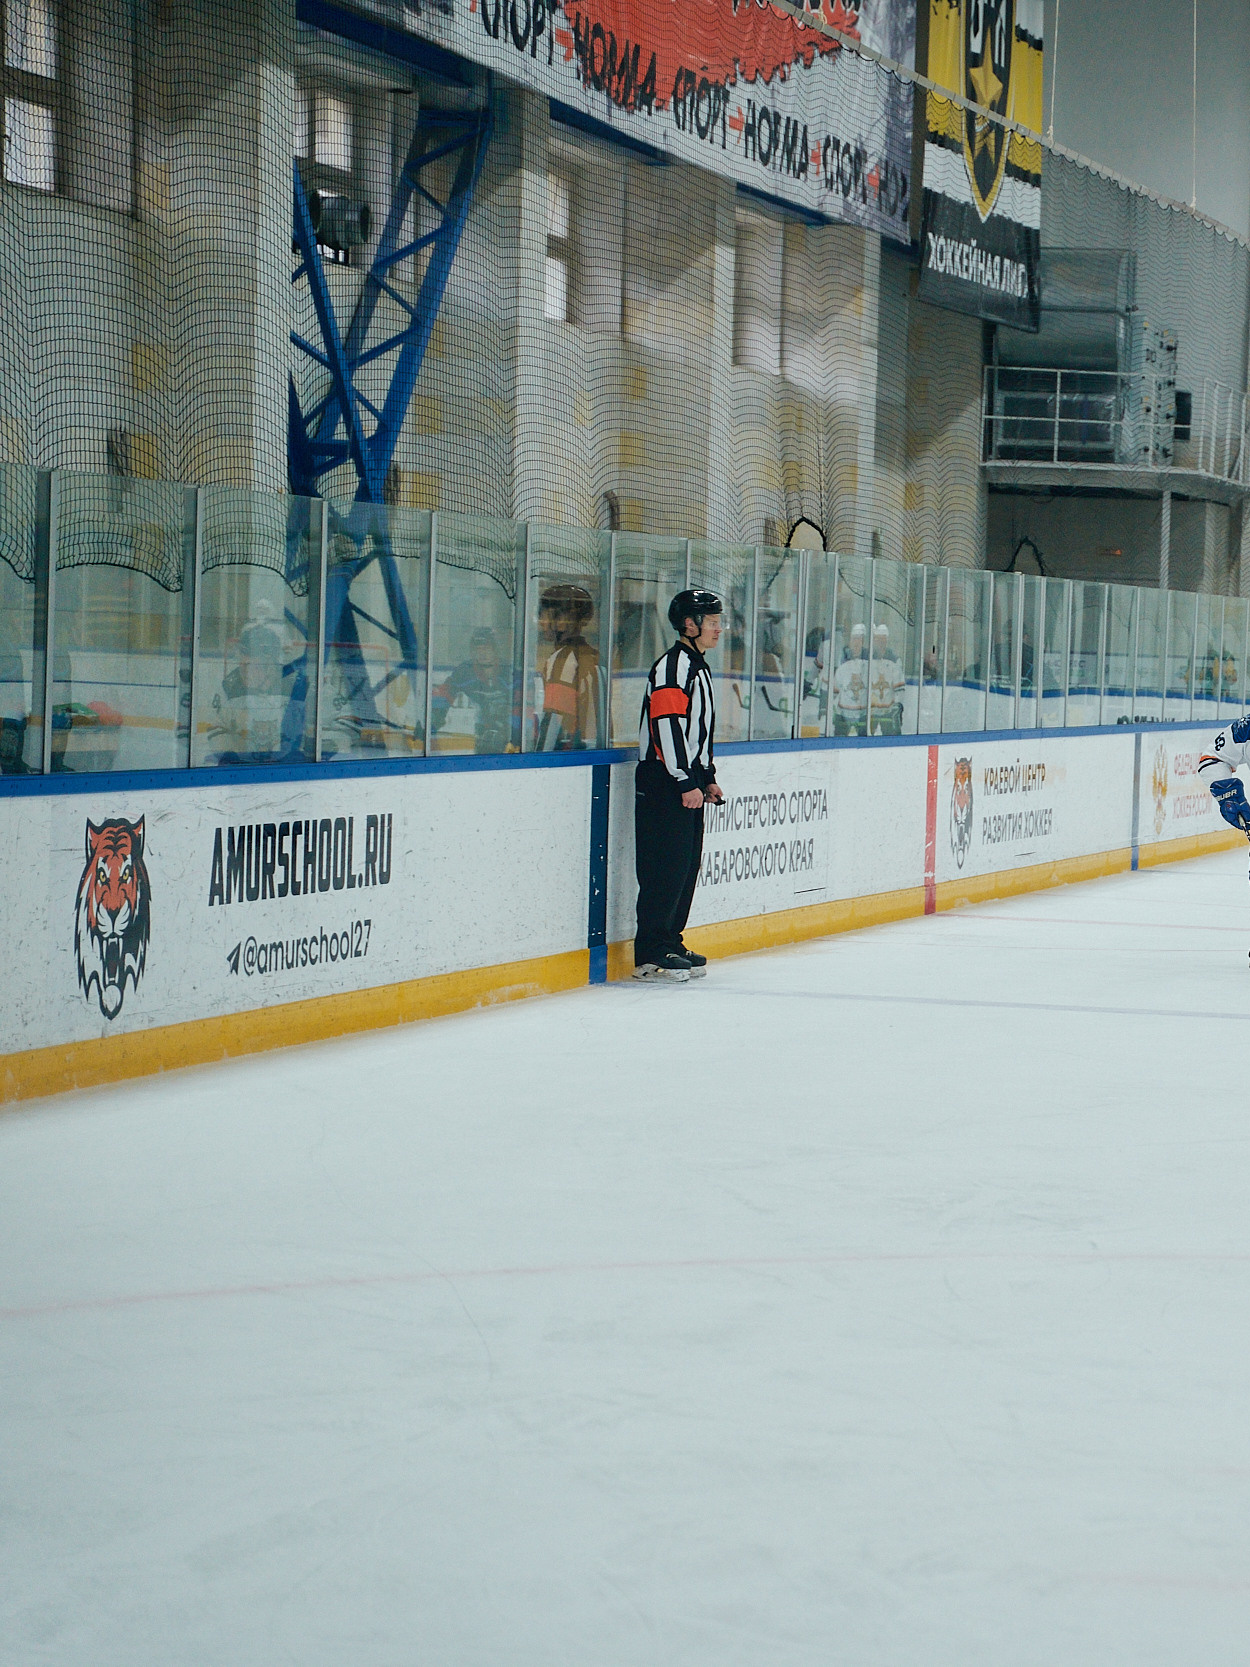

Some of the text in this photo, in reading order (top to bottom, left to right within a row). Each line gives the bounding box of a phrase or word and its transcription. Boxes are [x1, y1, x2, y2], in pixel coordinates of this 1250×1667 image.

[672, 65, 730, 149] СПОРТ
[744, 98, 809, 180] НОРМА
[928, 232, 1001, 290] ХОККЕЙНАЯ
[983, 757, 1046, 796] КРАЕВОЙ ЦЕНТР
[788, 789, 828, 824] СПОРТА
[982, 807, 1052, 845] РАЗВИТИЯ ХОККЕЯ
[208, 812, 393, 906] AMURSCHOOL.RU
[788, 838, 814, 873] КРАЯ
[244, 918, 372, 977] @amurschool27
